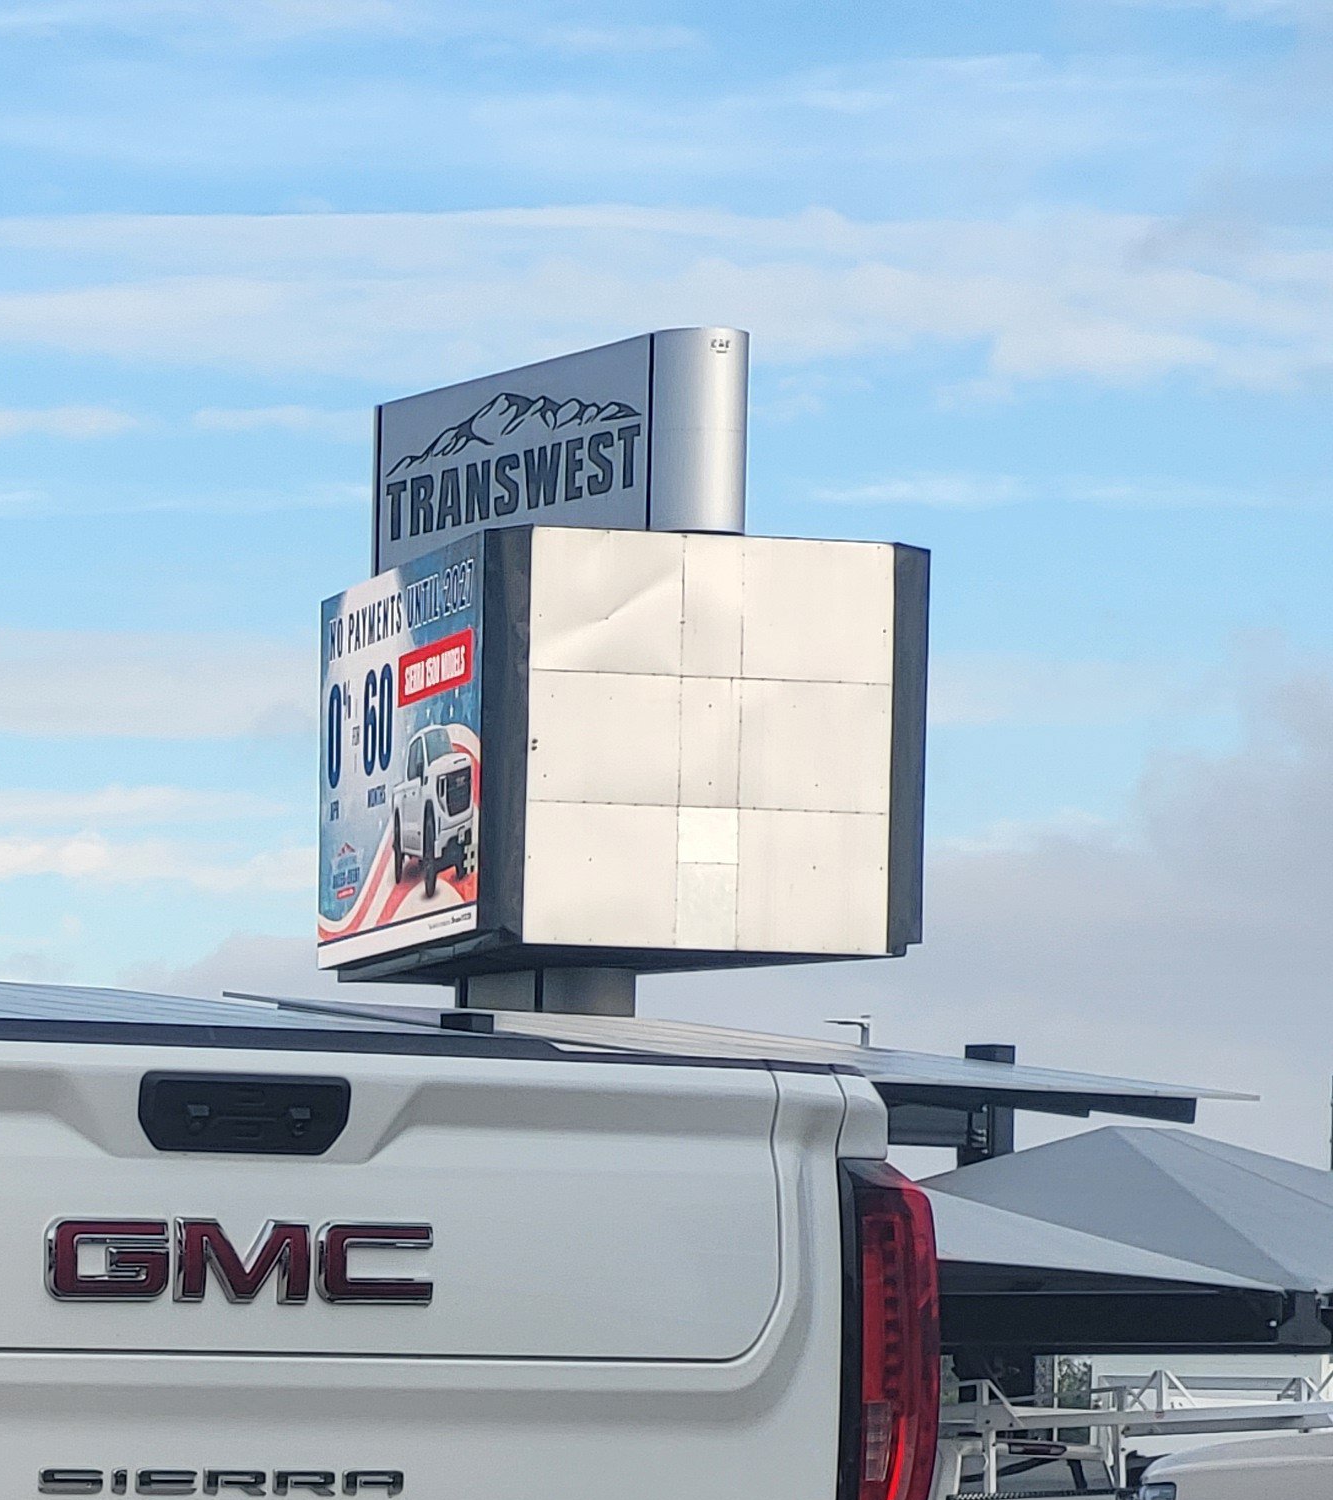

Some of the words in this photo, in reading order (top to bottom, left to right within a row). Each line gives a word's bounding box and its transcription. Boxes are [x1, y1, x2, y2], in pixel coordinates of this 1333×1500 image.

[386, 424, 641, 541] TRANSWEST
[328, 616, 344, 663] NO
[347, 590, 403, 654] PAYMENTS
[406, 573, 440, 631] UNTIL
[442, 558, 474, 616] 2027
[364, 663, 393, 776] 60
[43, 1216, 433, 1307] GMC
[37, 1468, 404, 1498] SIERRA
